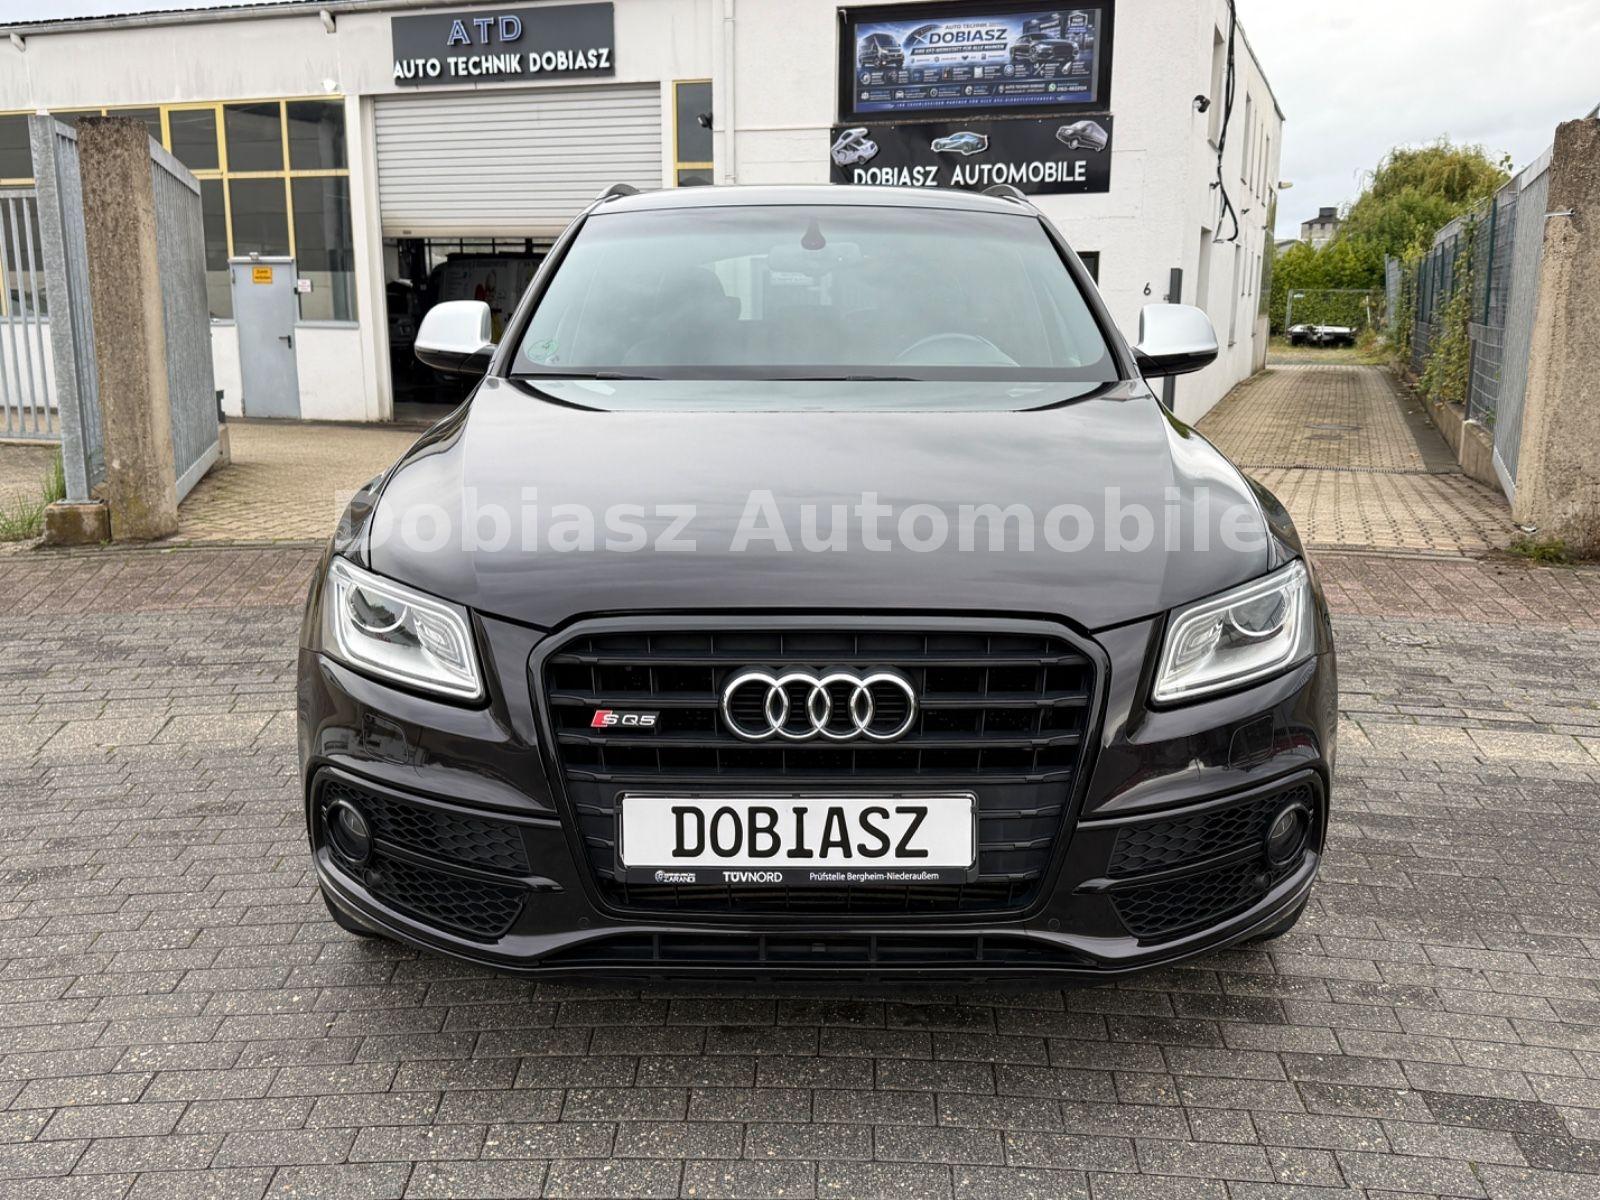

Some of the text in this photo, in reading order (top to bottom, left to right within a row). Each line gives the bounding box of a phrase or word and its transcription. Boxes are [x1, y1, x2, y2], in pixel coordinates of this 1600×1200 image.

[447, 15, 522, 46] ATD
[929, 29, 1008, 44] DOBIASZ
[392, 48, 610, 79] AUTO TECHNIK DOBIASZ
[854, 160, 1087, 186] DOBIASZ AUTOMOBILE
[1143, 282, 1152, 296] 6
[671, 806, 929, 859] DOBIASZ
[809, 871, 940, 882] Prüfstelle Bergheim-Niederaußem
